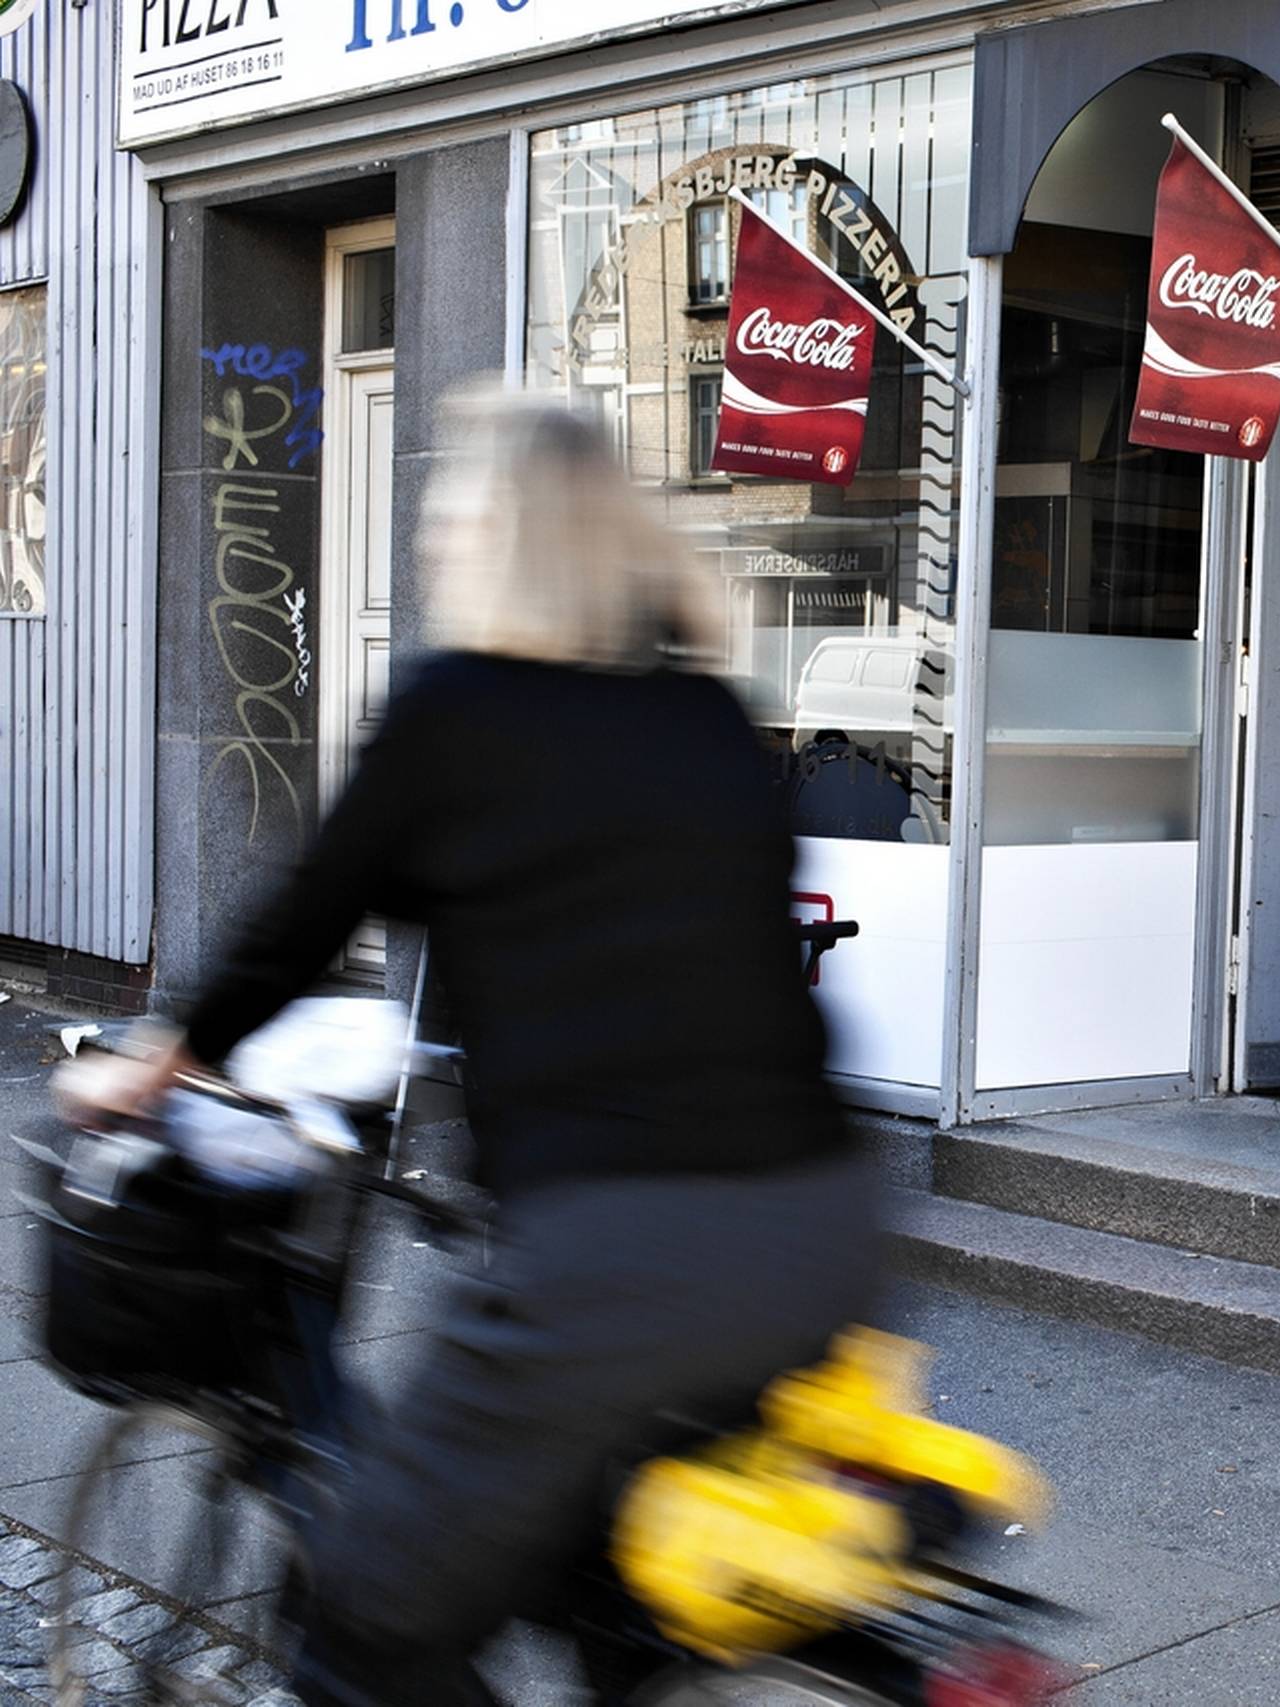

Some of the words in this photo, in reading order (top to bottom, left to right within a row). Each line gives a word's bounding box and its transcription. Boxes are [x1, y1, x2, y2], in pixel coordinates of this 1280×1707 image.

[132, 83, 155, 100] MAD
[157, 78, 173, 96] UD
[175, 73, 189, 92] AF
[190, 64, 224, 87] HUSET
[225, 60, 238, 78] 86
[257, 53, 270, 71] 16
[273, 50, 284, 67] 11
[804, 170, 918, 343] PIZZERIA
[736, 307, 866, 370] Coca-Cola
